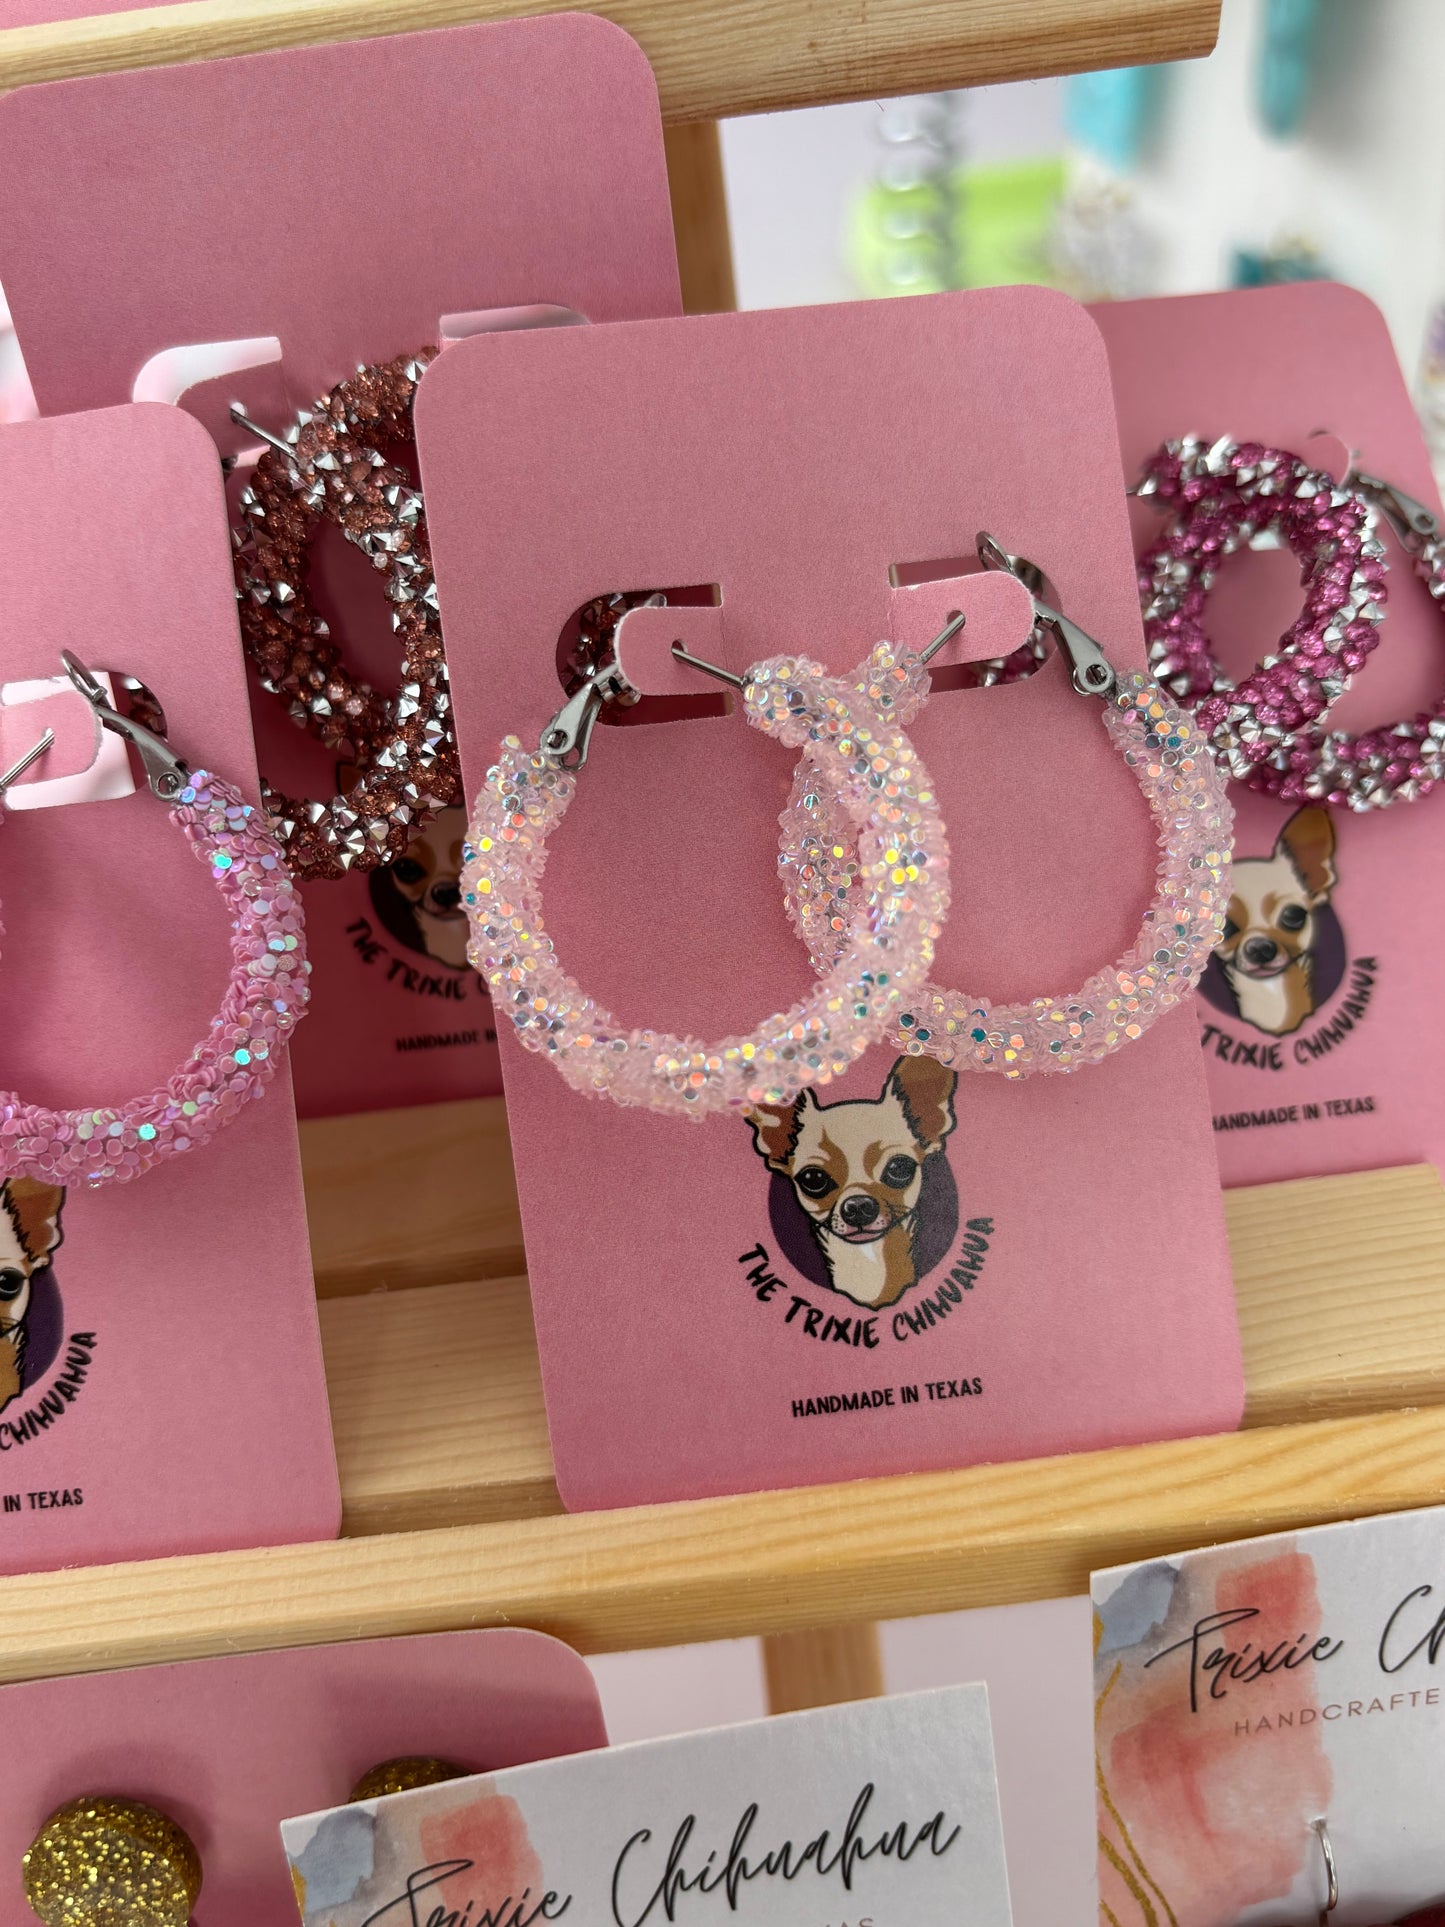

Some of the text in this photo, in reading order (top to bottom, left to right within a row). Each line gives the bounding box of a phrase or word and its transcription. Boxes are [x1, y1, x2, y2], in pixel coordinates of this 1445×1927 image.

[345, 915, 388, 965] THE
[387, 958, 467, 1001] TRIXIE
[396, 1029, 478, 1053] HANDMADE
[1201, 956, 1378, 1071] TRIXIE CHIHUAHUA
[1302, 1103, 1320, 1120] IN
[1324, 1096, 1375, 1117] TEXAS
[738, 1216, 995, 1349] THE TRIXIE CHIHUAHUA
[0, 1331, 98, 1451] CHIHUAHUA
[791, 1376, 983, 1418] HANDMADE IN TEXAS
[3, 1488, 84, 1512] IN TEXAS
[1144, 1608, 1344, 1714] Trixie
[1234, 1687, 1440, 1738] HANDCRAFTE
[611, 1782, 962, 1927] Chihuahua
